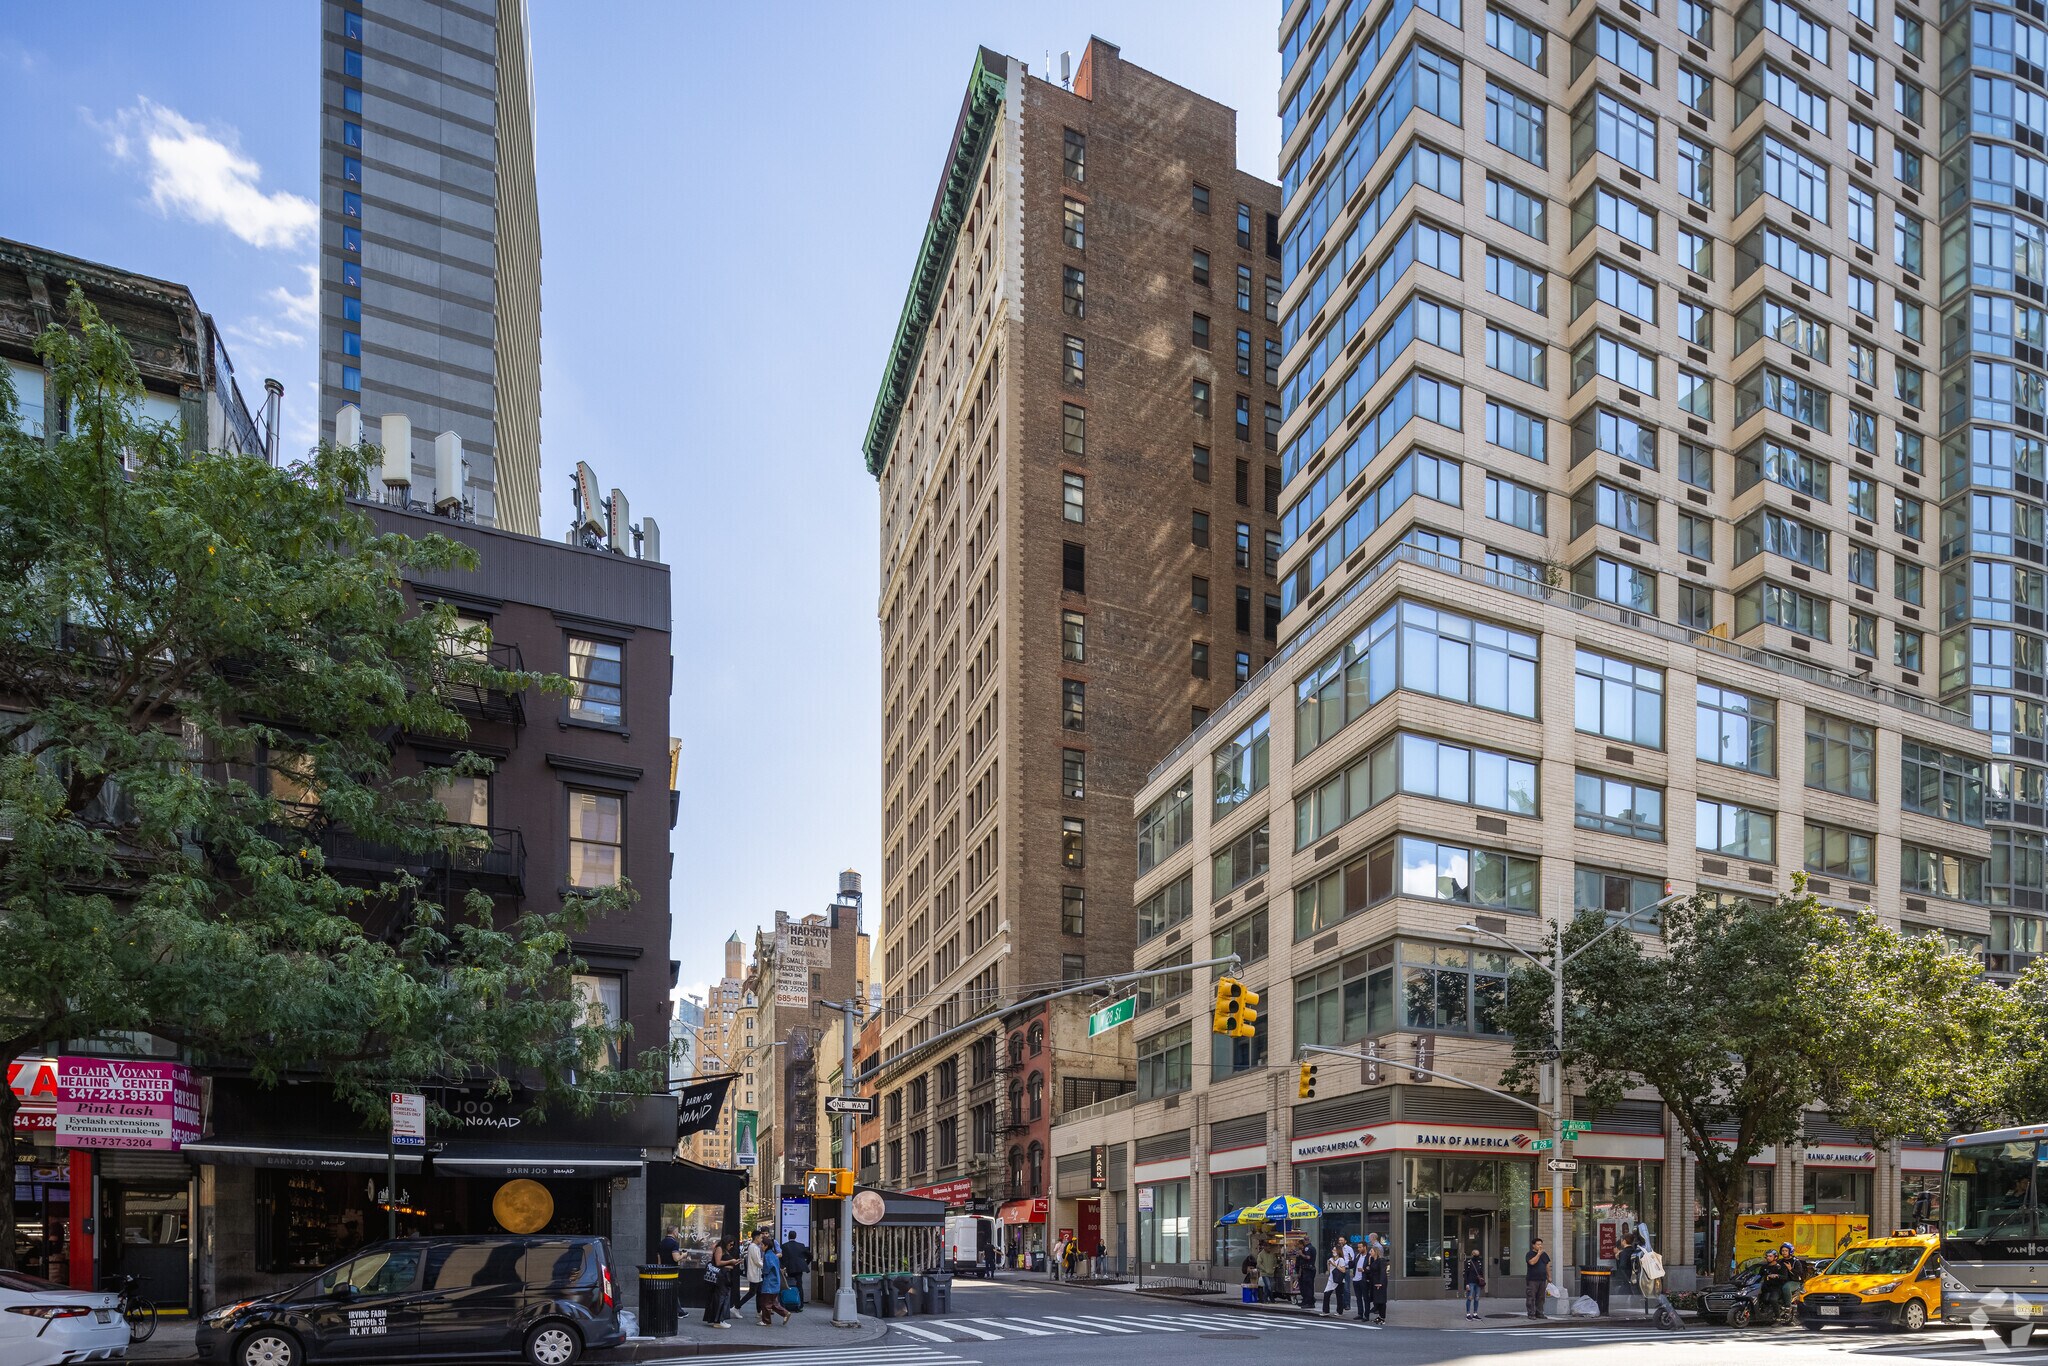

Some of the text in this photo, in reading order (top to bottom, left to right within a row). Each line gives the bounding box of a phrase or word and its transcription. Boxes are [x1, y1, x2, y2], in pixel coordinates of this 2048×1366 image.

[578, 464, 590, 510] TRANSMITTER
[790, 936, 828, 949] REALTY
[786, 957, 805, 966] SMALL
[777, 994, 807, 1003] 685-4141
[1114, 1007, 1122, 1021] St
[1368, 1041, 1376, 1072] PAK
[60, 1077, 169, 1089] HEALING CENTER
[68, 1088, 164, 1101] 347-243-9530
[173, 1088, 200, 1109] CRYSTAL
[394, 1094, 400, 1103] 3
[685, 1096, 702, 1106] BARN
[76, 1103, 153, 1116] Pink lash
[453, 1101, 494, 1115] JOO
[173, 1105, 200, 1126] BOUTIQUE
[69, 1117, 160, 1127] Eyelash extensions
[65, 1124, 163, 1136] Permanent make-up
[77, 1136, 152, 1147] 718-737-3204
[1417, 1135, 1510, 1147] BANK OF AMERICA
[1540, 1141, 1547, 1149] 28
[1298, 1140, 1359, 1156] BANK OF AMERICA
[294, 1158, 314, 1166] JOO
[348, 1309, 387, 1319] IRVING FARM
[350, 1317, 386, 1327] 151W19th ST
[349, 1326, 387, 1336] NY, NY 10011
